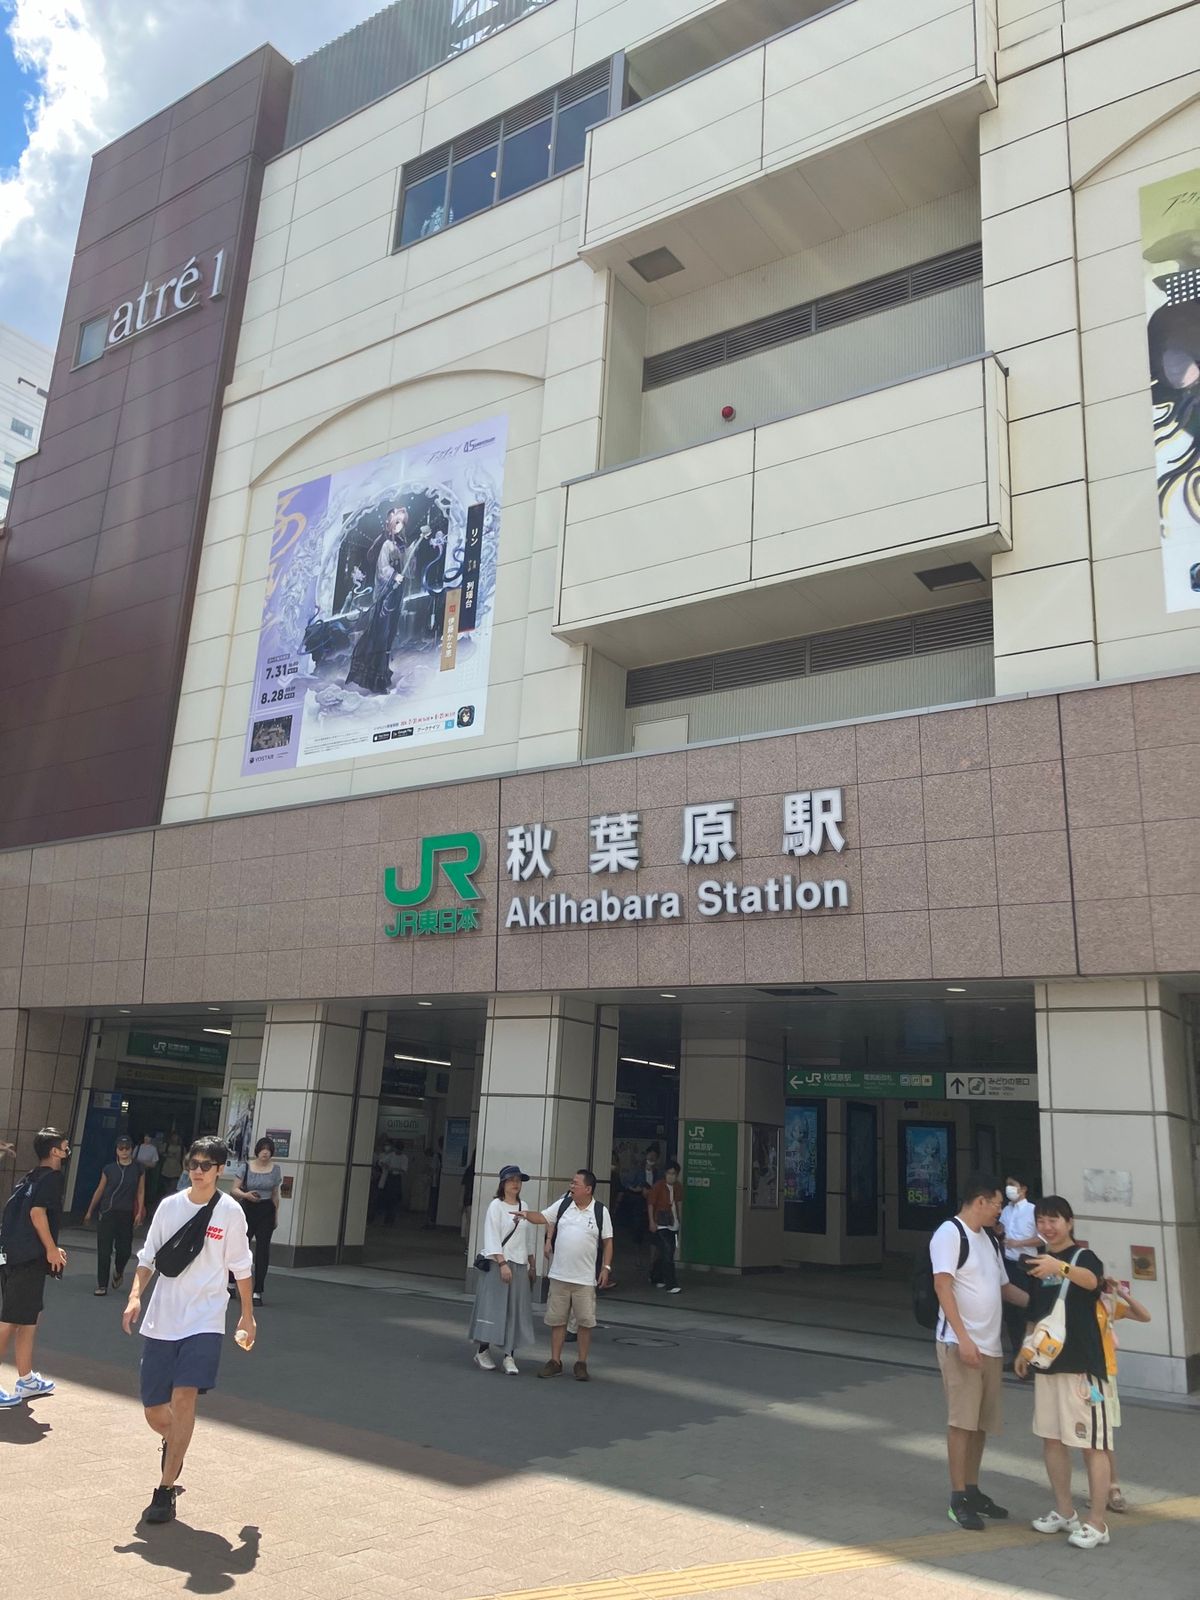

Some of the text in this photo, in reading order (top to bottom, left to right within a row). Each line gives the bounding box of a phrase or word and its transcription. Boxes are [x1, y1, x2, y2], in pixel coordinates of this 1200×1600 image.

[108, 256, 200, 344] atré
[266, 664, 287, 680] 7.31
[261, 689, 284, 704] 8.28
[505, 786, 846, 882] 秋葉原駅
[383, 831, 482, 907] JR
[505, 875, 850, 930] Akihabara Station
[384, 905, 479, 938] JR東日本
[805, 1073, 821, 1083] JR
[688, 1126, 705, 1138] JR
